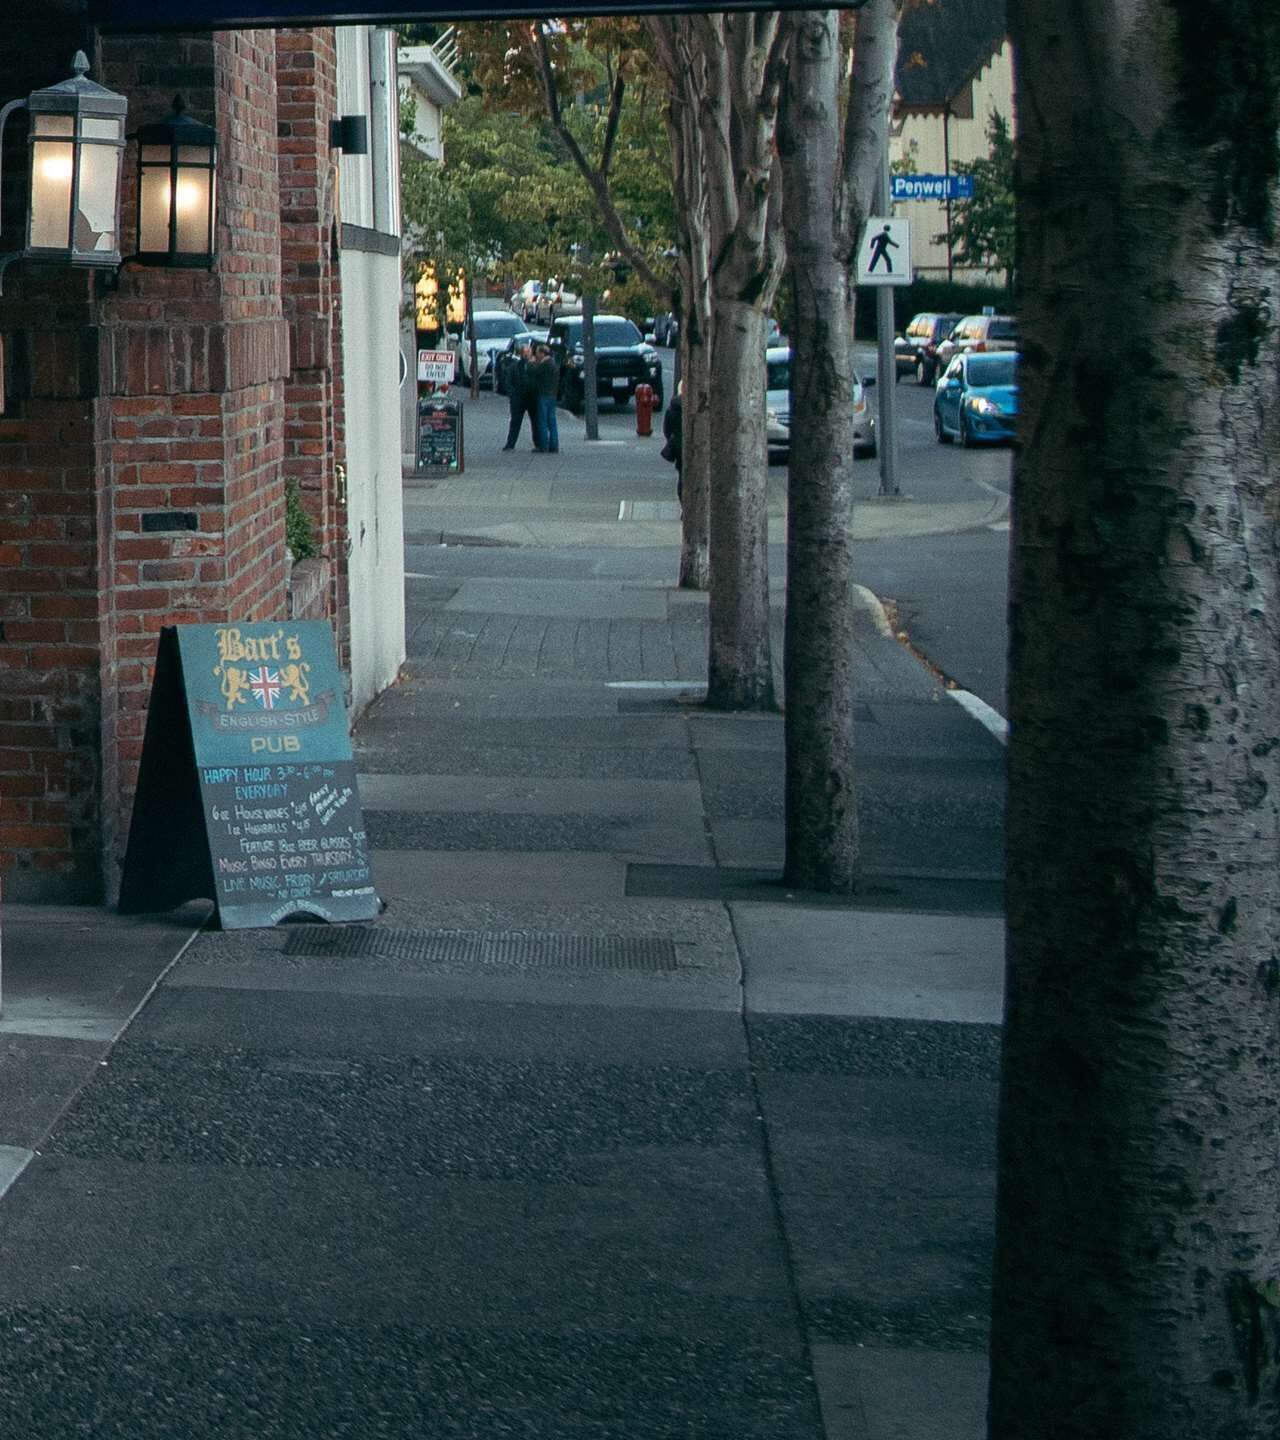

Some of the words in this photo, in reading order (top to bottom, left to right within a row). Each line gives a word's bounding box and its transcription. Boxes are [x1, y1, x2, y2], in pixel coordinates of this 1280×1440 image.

[895, 178, 951, 194] Penwell
[421, 353, 435, 361] EXIT
[436, 354, 452, 362] ONLY
[214, 628, 302, 667] Bart's
[250, 735, 301, 753] PUB
[203, 766, 239, 784] HAPPY
[244, 766, 272, 782] HOUR
[235, 783, 288, 800] EVERYDAY
